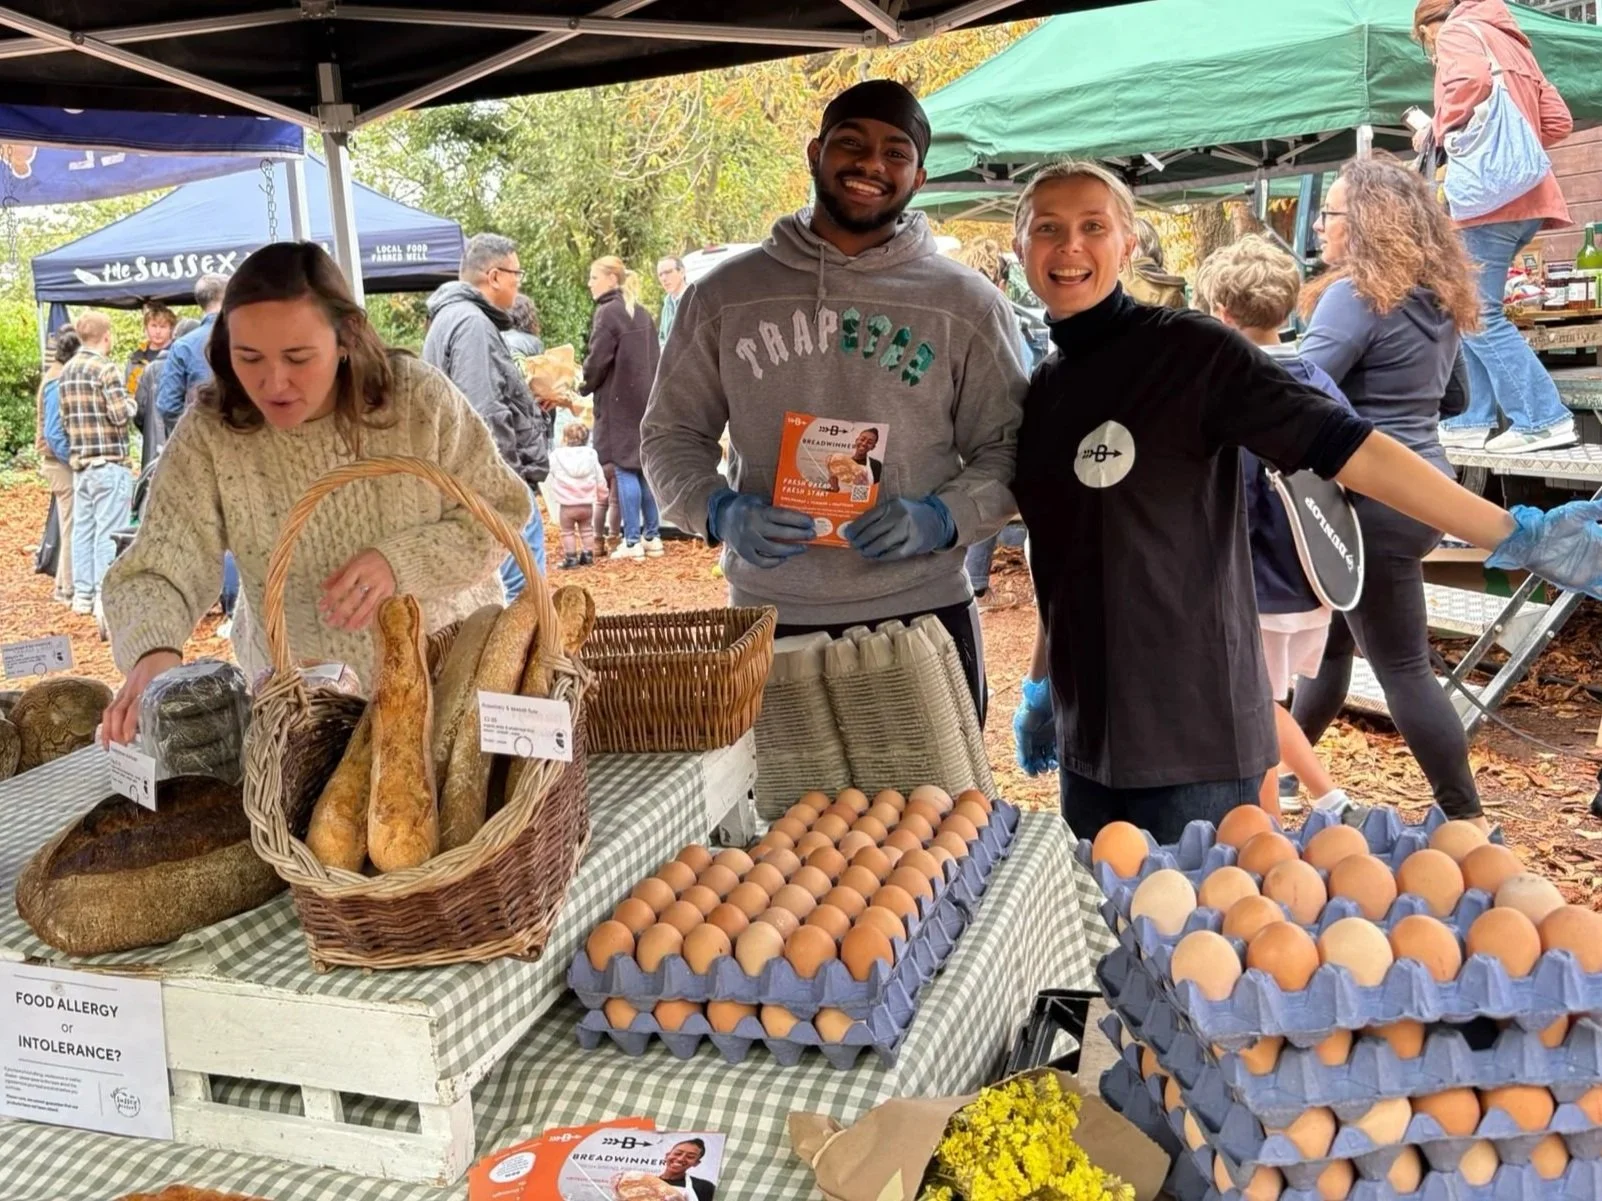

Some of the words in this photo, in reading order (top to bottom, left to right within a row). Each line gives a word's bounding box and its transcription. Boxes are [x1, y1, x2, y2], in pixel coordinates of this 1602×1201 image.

[376, 244, 402, 254] LOCAL
[406, 243, 428, 253] FOOD
[406, 252, 428, 261] WELL
[735, 305, 936, 387] TRAPSTAR
[1304, 496, 1348, 559] DUNLOP
[16, 991, 54, 1009] FOOD
[57, 998, 118, 1018] ALLERGY
[61, 1023, 73, 1034] or
[18, 1035, 121, 1062] INTOLERANCE?
[572, 1153, 667, 1166] BREADWINNER
